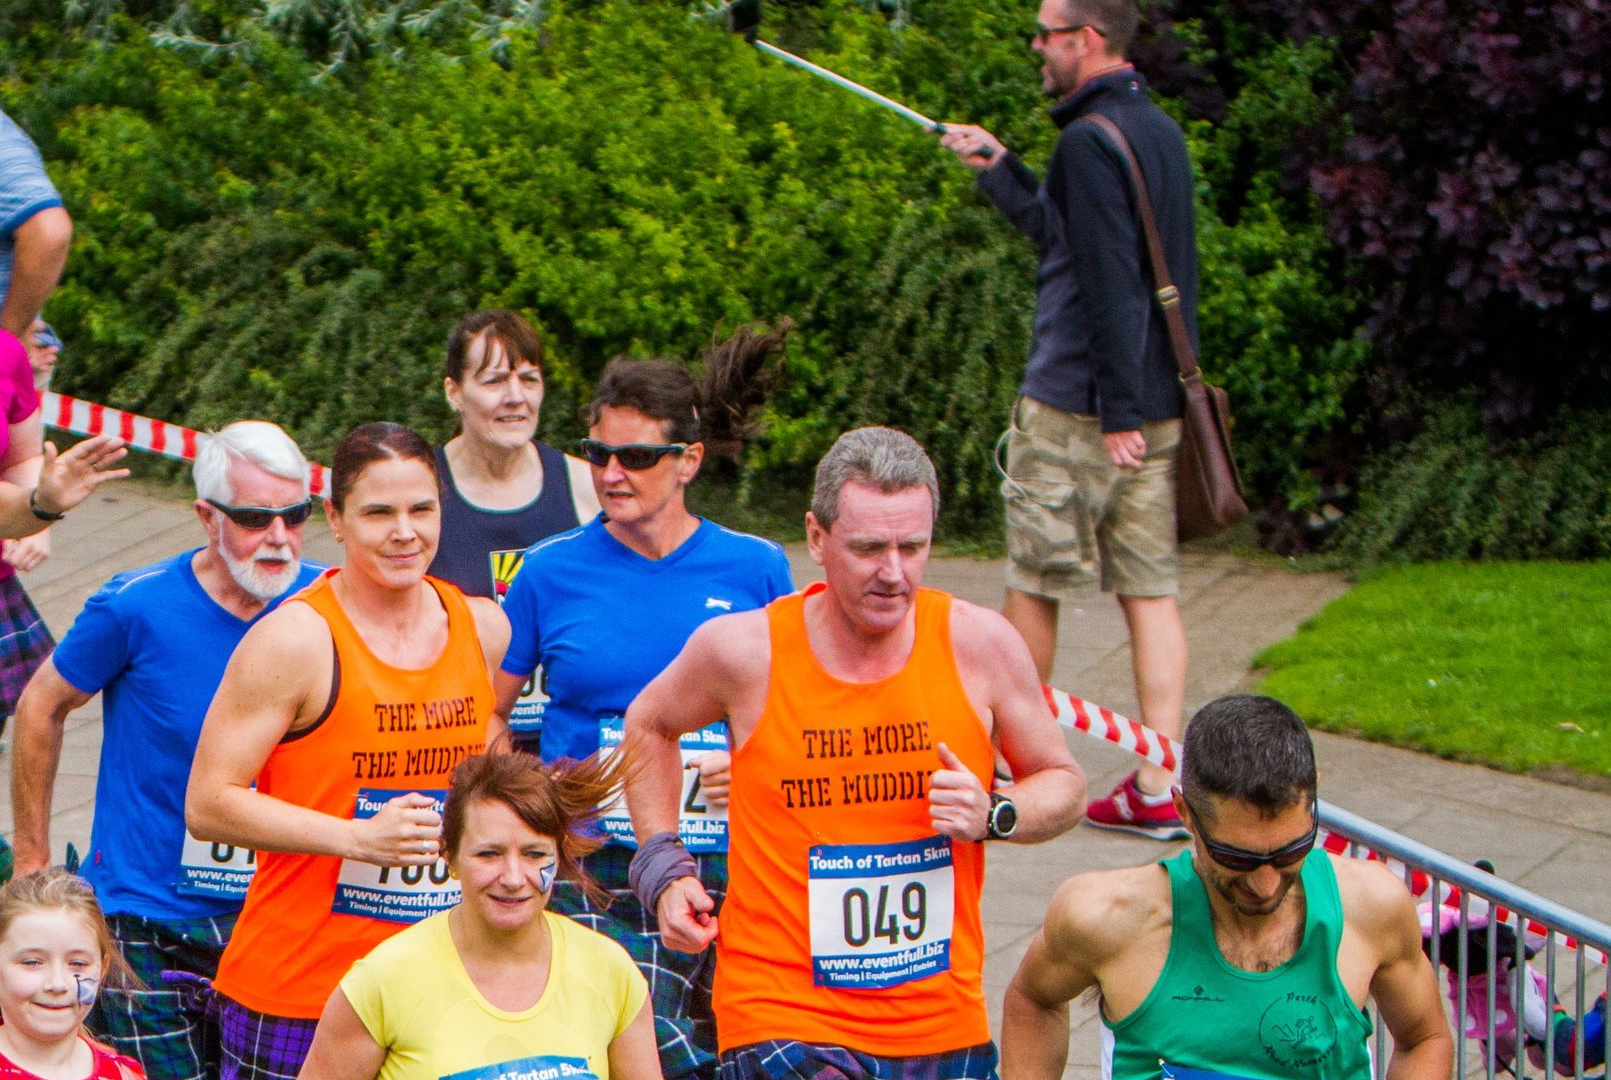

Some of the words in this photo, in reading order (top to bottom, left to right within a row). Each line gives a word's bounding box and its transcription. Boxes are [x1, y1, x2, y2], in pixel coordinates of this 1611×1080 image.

[375, 703, 417, 732] THE
[423, 696, 477, 730] MORE
[803, 729, 853, 759] THE
[863, 721, 932, 755] MORE
[353, 752, 398, 779] THE
[782, 778, 832, 808] THE
[842, 771, 933, 804] MUDDI
[810, 856, 854, 870] Touch
[857, 855, 873, 869] of
[874, 854, 921, 868] Tartan
[924, 846, 951, 862] 5km
[349, 901, 382, 914] Timing
[383, 908, 426, 918] Equipment
[843, 881, 927, 948] 049
[819, 942, 945, 971] www.eventfull.biz
[829, 972, 860, 982] Timing
[866, 968, 909, 980] Equipment
[913, 960, 937, 972] Entries
